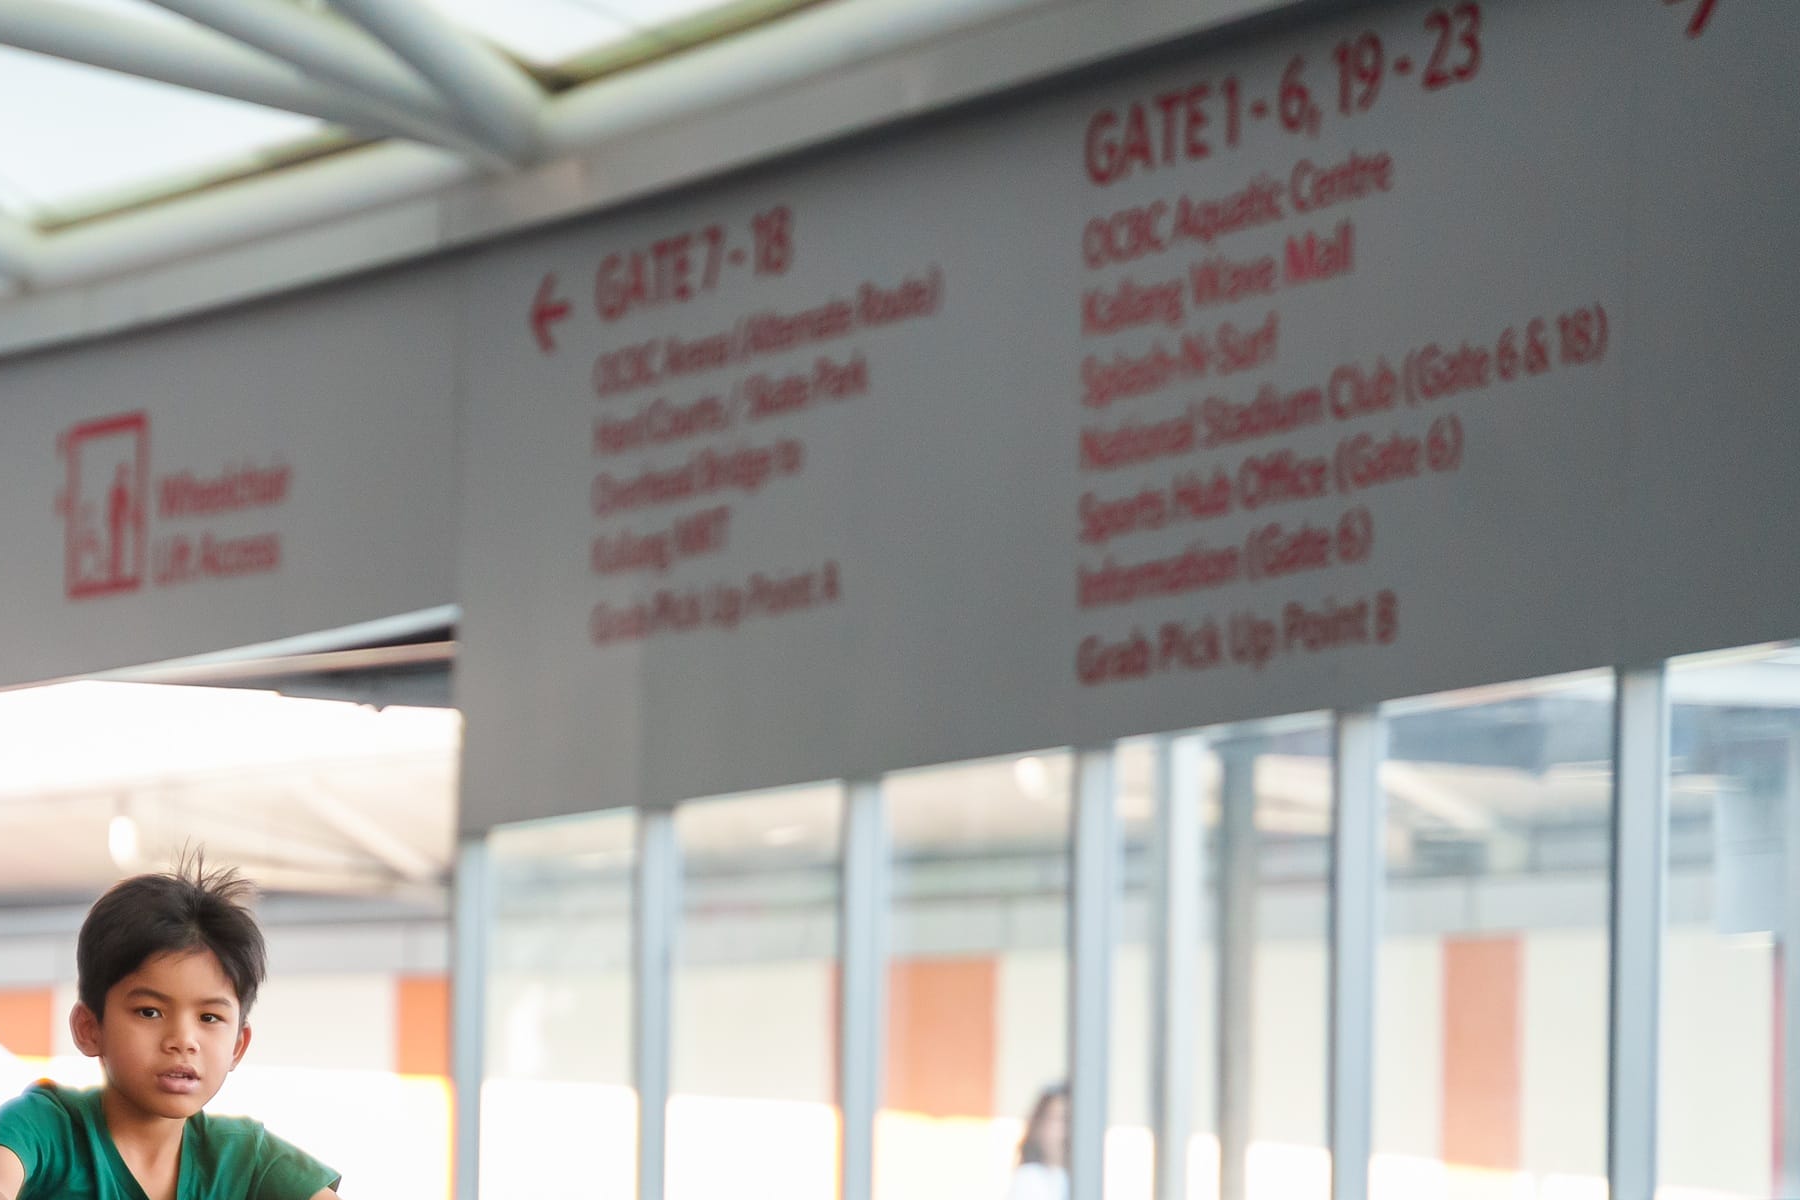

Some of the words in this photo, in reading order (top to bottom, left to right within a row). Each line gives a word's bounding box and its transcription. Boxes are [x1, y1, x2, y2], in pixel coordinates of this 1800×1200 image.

[1084, 84, 1211, 188] GATE
[1172, 176, 1285, 247] Aquatic
[1289, 147, 1394, 212] Centre
[596, 233, 693, 322] GATE
[1284, 215, 1355, 286] Mall
[1200, 381, 1322, 449] Stadium
[1327, 359, 1397, 421] Club
[1238, 448, 1327, 510] Office
[1076, 633, 1151, 686] Grab
[1158, 620, 1221, 671] Pick
[1228, 611, 1277, 669] Up
[1282, 594, 1369, 651] Point
